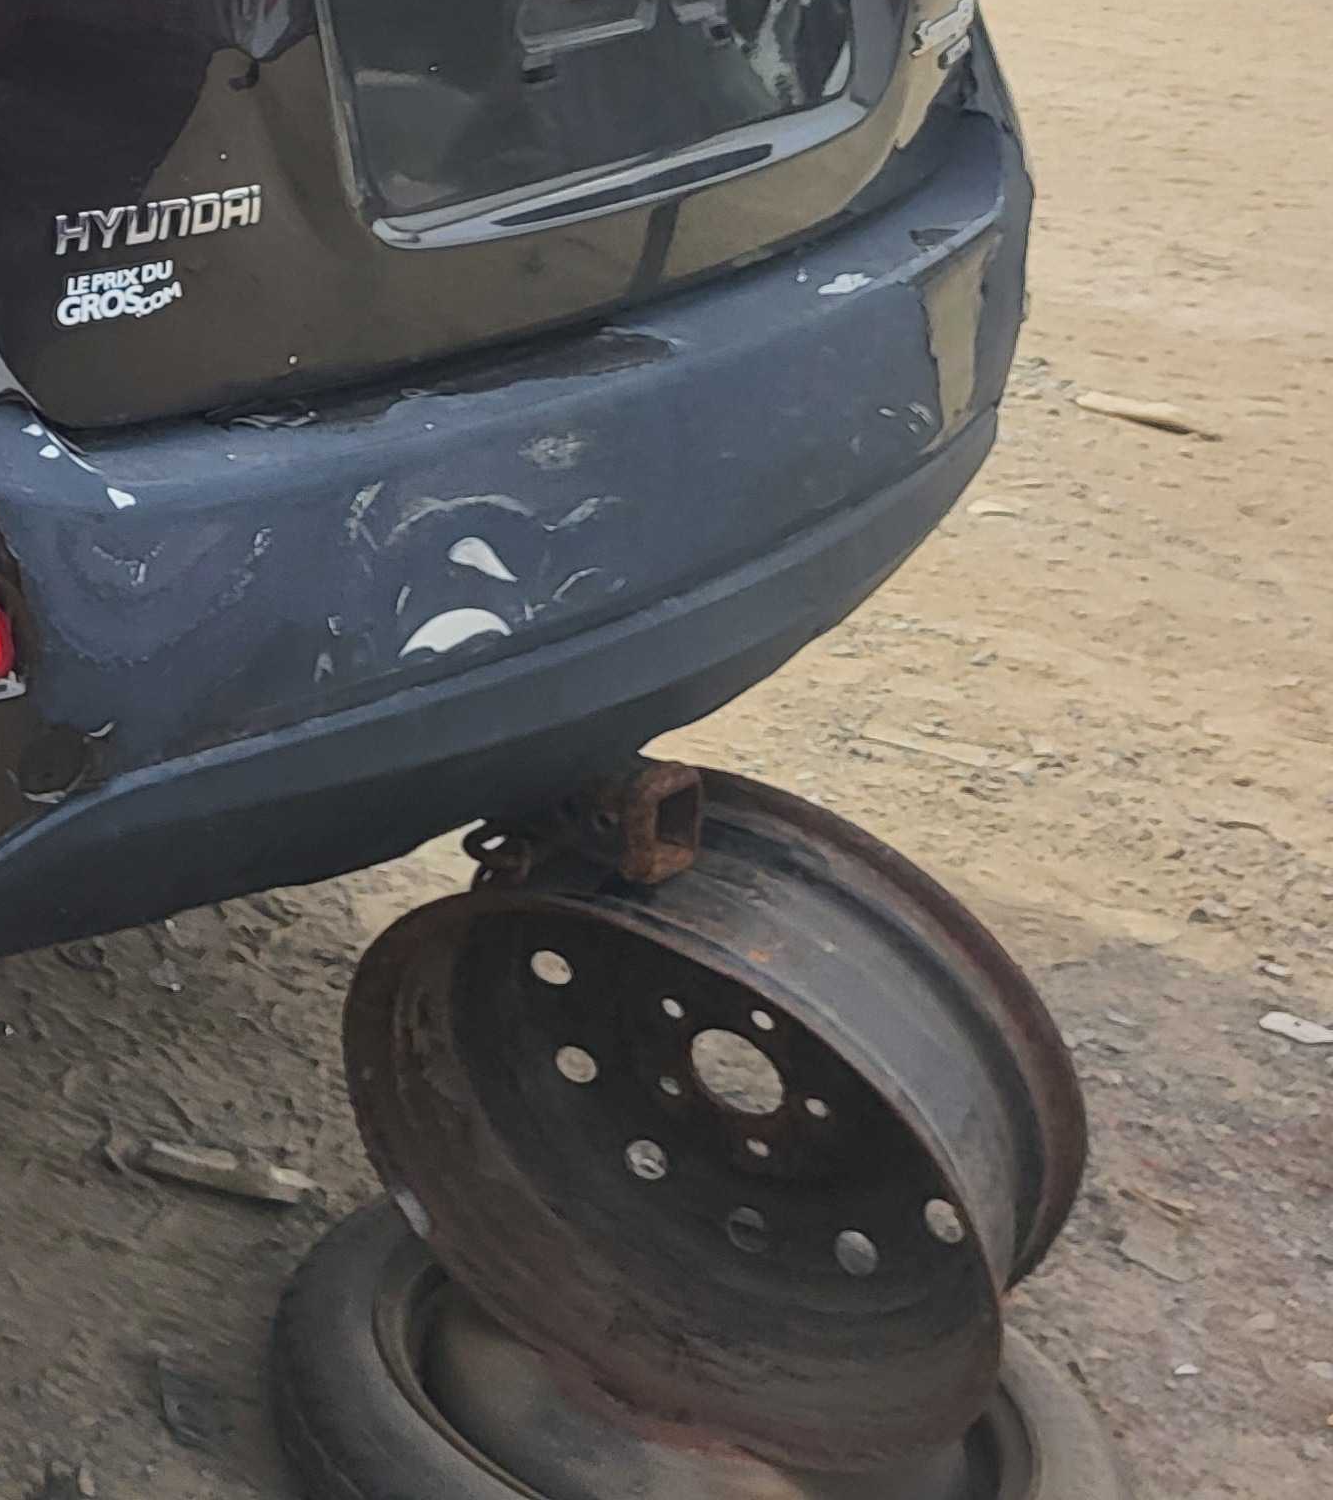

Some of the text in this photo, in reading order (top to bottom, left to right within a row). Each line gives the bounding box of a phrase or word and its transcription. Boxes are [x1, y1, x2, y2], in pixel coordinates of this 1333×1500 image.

[66, 260, 174, 296] LE PRIX DU
